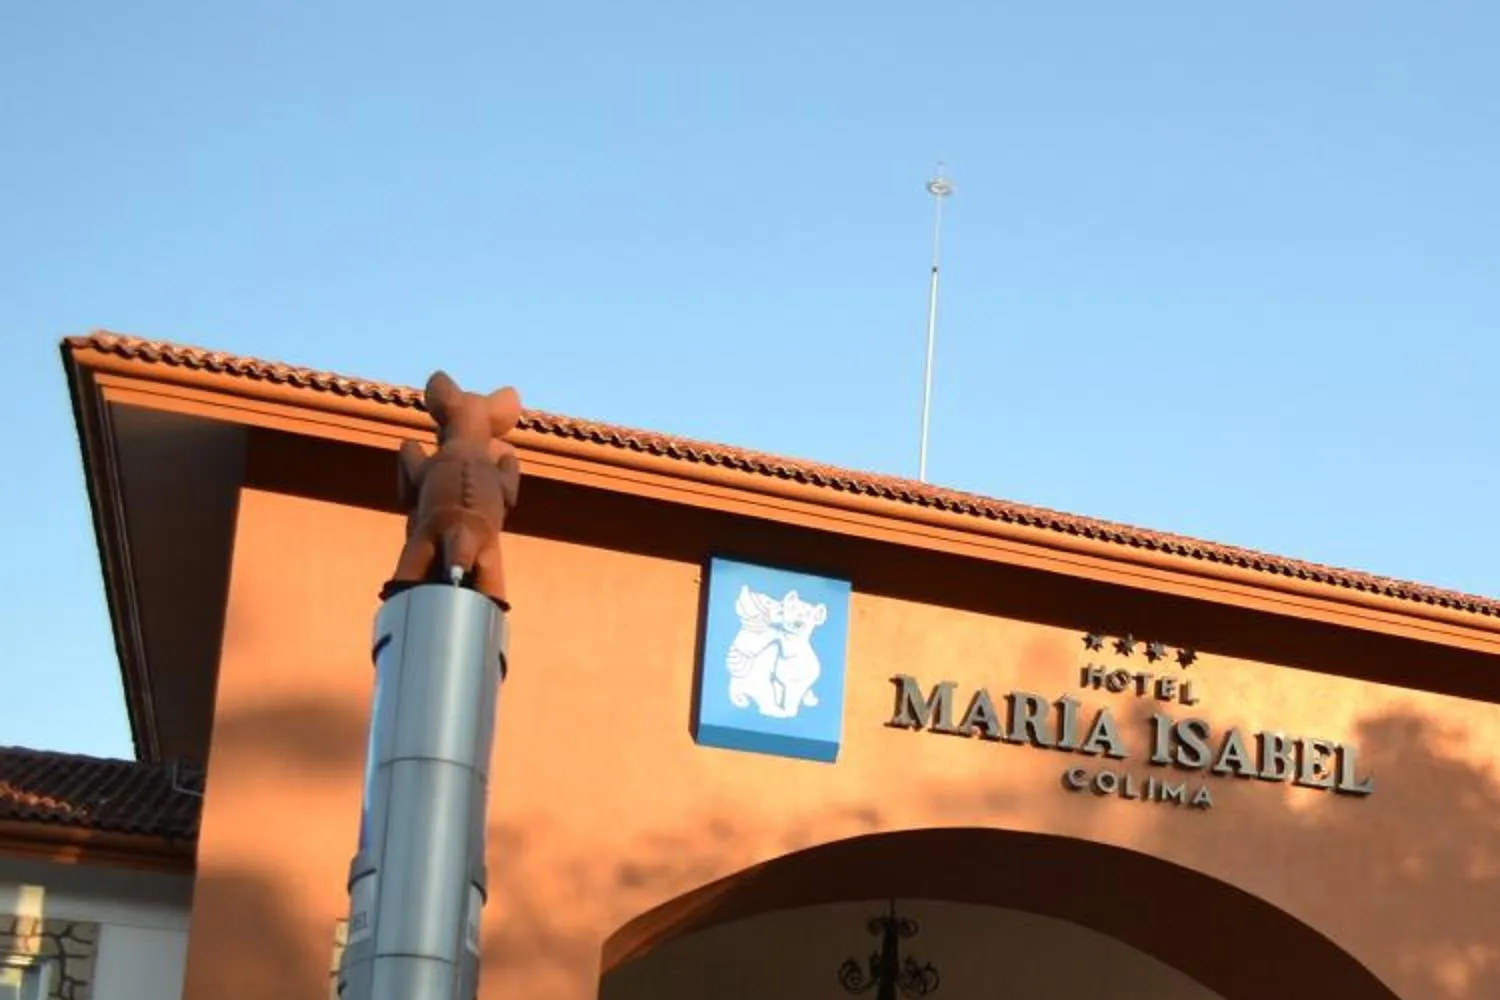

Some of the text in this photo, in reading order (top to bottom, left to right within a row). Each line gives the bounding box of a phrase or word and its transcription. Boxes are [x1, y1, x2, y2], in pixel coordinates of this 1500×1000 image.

[1079, 663, 1200, 706] HOTEL
[1150, 712, 1375, 796] ISABEL
[1062, 766, 1214, 809] COLIMA
